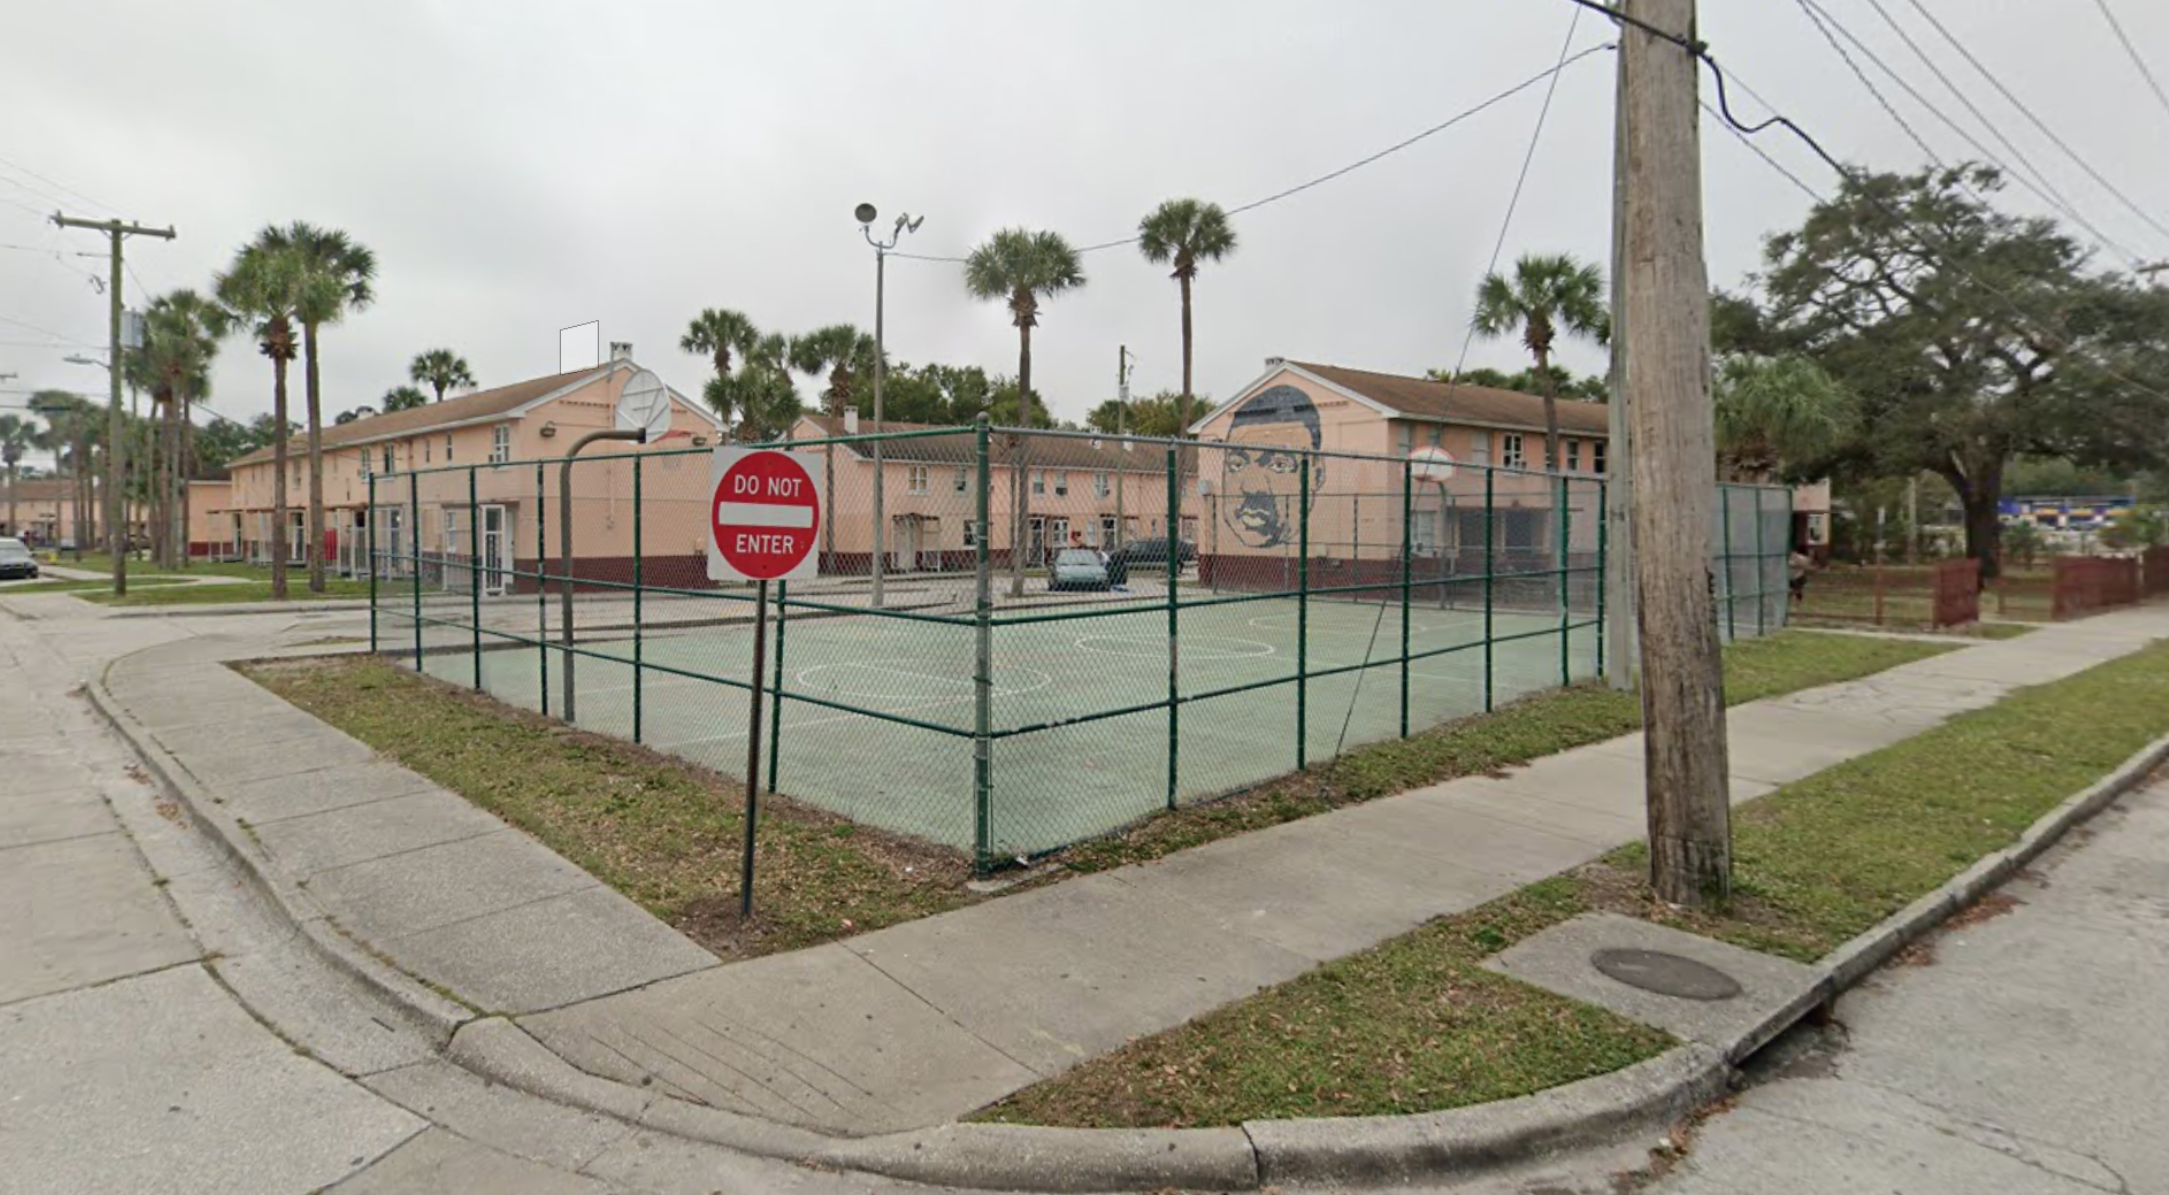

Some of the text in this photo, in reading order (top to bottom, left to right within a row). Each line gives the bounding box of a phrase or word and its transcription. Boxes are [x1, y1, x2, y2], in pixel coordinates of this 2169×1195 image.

[734, 475, 802, 497] DO NOT
[736, 534, 794, 554] ENTER
